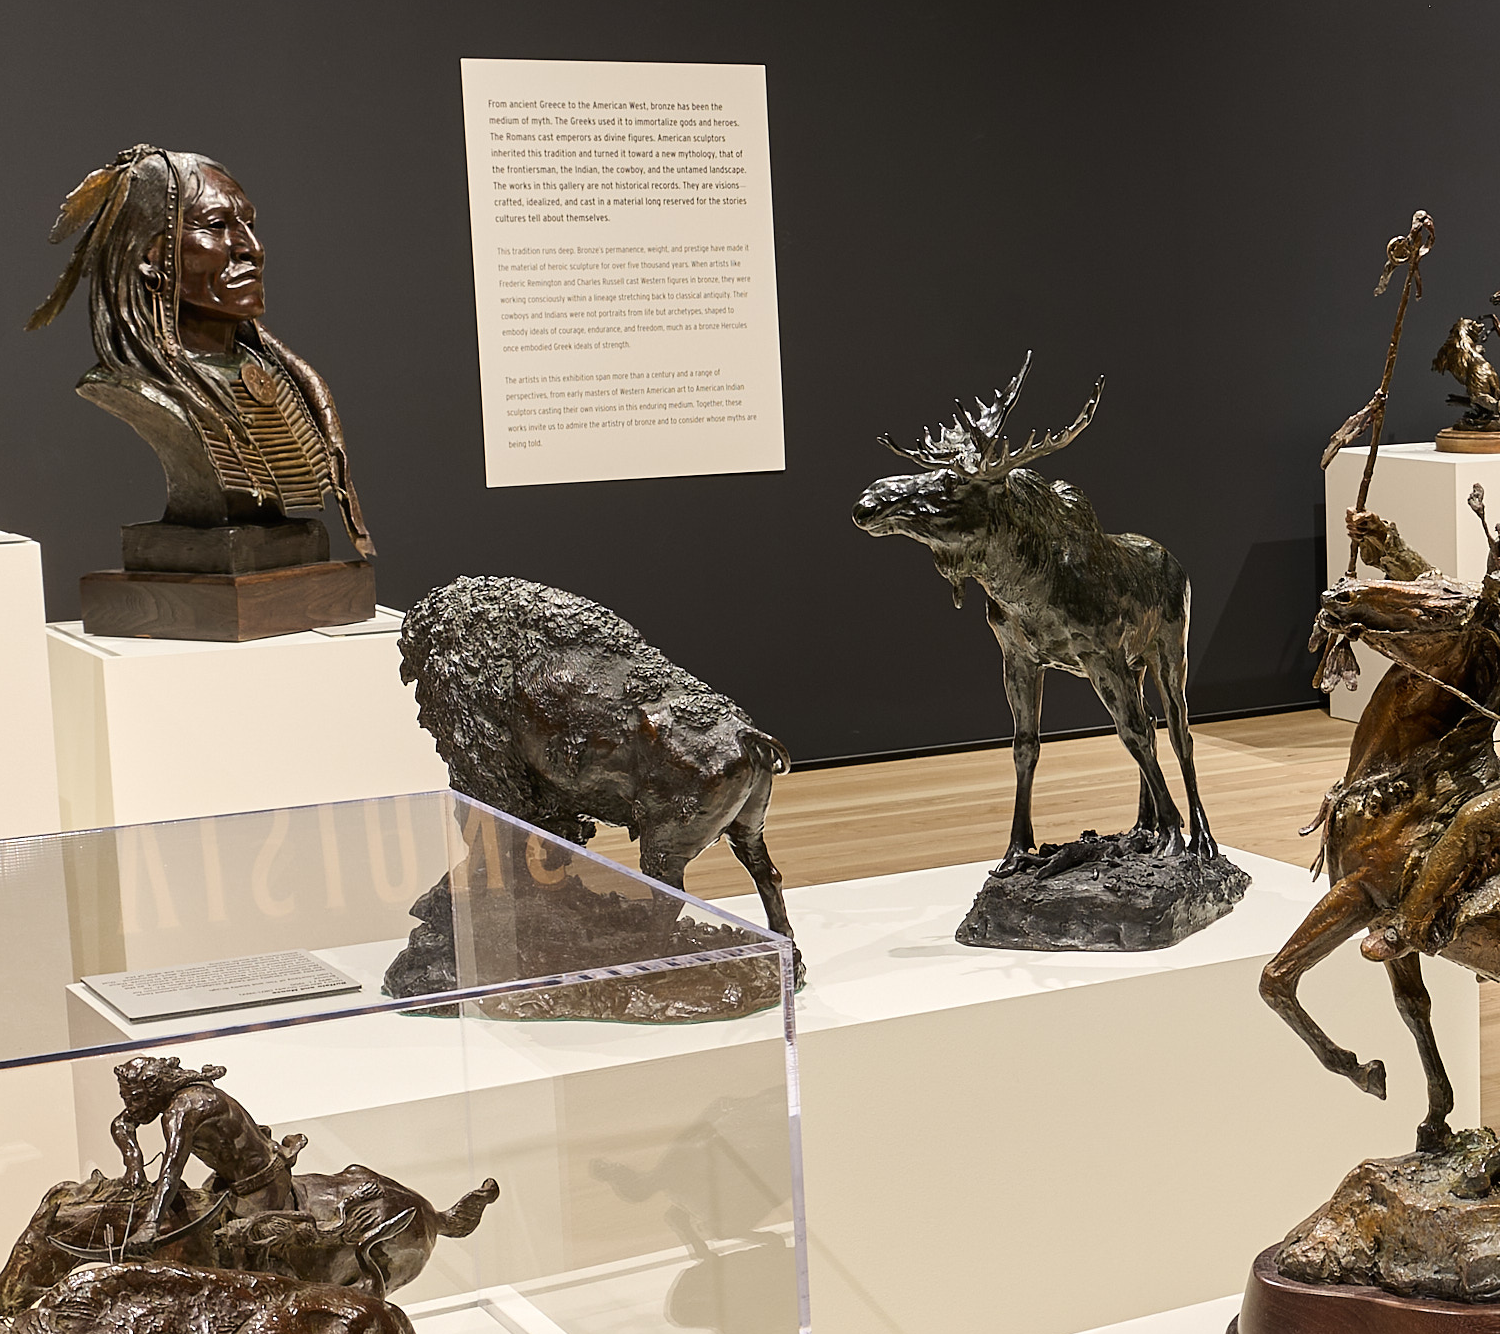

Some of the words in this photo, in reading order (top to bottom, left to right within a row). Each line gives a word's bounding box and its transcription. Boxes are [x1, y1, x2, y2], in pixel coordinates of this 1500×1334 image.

[488, 99, 507, 108] From
[509, 100, 537, 109] ancient
[539, 100, 566, 109] Greece
[568, 101, 576, 109] to
[578, 101, 591, 109] the
[592, 101, 627, 110] American
[629, 102, 649, 111] West,
[650, 102, 675, 111] bronze
[677, 102, 690, 110] has
[691, 102, 709, 111] been
[711, 103, 723, 111] the
[489, 116, 520, 125] medium
[521, 116, 529, 125] of
[531, 117, 553, 126] myth.
[554, 116, 568, 125] The
[570, 116, 596, 126] Greeks
[598, 117, 616, 126] used
[617, 117, 623, 126] it
[625, 118, 633, 126] to
[634, 117, 678, 126] immortalize
[679, 118, 697, 128] gods
[698, 118, 712, 127] and
[713, 118, 740, 127] heroes.
[490, 132, 504, 141] The
[506, 132, 536, 141] Romans
[538, 133, 554, 141] cast
[556, 134, 592, 143] emperors
[603, 133, 626, 142] divine
[628, 133, 656, 143] figures.
[657, 134, 691, 142] American
[693, 134, 726, 144] sculptors
[491, 149, 526, 158] inherited
[527, 149, 542, 157] this
[544, 149, 577, 158] tradition
[578, 149, 592, 158] and
[594, 149, 619, 158] turned
[620, 149, 626, 158] it
[628, 150, 653, 158] toward
[678, 150, 718, 160] mythology,
[719, 150, 734, 158] that
[735, 149, 743, 158] of
[492, 165, 505, 174] the
[507, 165, 559, 175] frontiersman,
[560, 165, 573, 174] the
[574, 165, 600, 175] Indian,
[602, 166, 614, 174] the
[616, 165, 646, 175] cowboy,
[647, 165, 661, 174] and
[662, 165, 675, 174] the
[676, 165, 708, 174] untamed
[709, 166, 747, 175] landscape.
[493, 181, 507, 190] The
[509, 182, 532, 190] works
[533, 181, 541, 190] in
[542, 182, 557, 190] this
[559, 181, 585, 191] gallery
[601, 182, 613, 190] not
[615, 181, 650, 190] historical
[651, 181, 681, 190] records.
[683, 181, 699, 191] They
[494, 198, 524, 207] crafted,
[526, 198, 563, 207] idealized,
[564, 198, 578, 206] and
[580, 197, 596, 206] cast
[597, 197, 605, 205] in
[613, 197, 644, 206] material
[645, 197, 661, 207] long
[663, 197, 695, 205] reserved
[696, 197, 707, 205] for
[708, 197, 721, 205] the
[722, 197, 747, 205] stories
[495, 214, 526, 223] cultures
[528, 214, 541, 222] tell
[542, 214, 564, 222] about
[566, 213, 610, 222] themselves.
[497, 247, 511, 255] This
[512, 247, 541, 255] tradition
[671, 245, 683, 253] and
[684, 245, 709, 254] prestige
[710, 244, 725, 252] have
[726, 244, 743, 252] made
[499, 279, 526, 288] Frederic
[527, 279, 562, 288] Remington
[577, 278, 601, 286] Charles
[602, 277, 625, 286] Russell
[626, 277, 639, 285] cast
[640, 277, 666, 285] Western
[667, 276, 689, 285] figures
[721, 276, 735, 284] they
[520, 343, 552, 352] embodied
[553, 342, 572, 351] Greek
[574, 342, 593, 350] ideals
[594, 341, 601, 349] of
[550, 390, 566, 398] from
[567, 390, 583, 399] early
[584, 389, 610, 397] masters
[611, 388, 618, 396] of
[619, 388, 645, 396] Western
[646, 386, 676, 394] American
[677, 385, 686, 393] art
[687, 385, 695, 393] to
[696, 384, 725, 392] American
[726, 383, 745, 391] Indian
[508, 440, 527, 449] being
